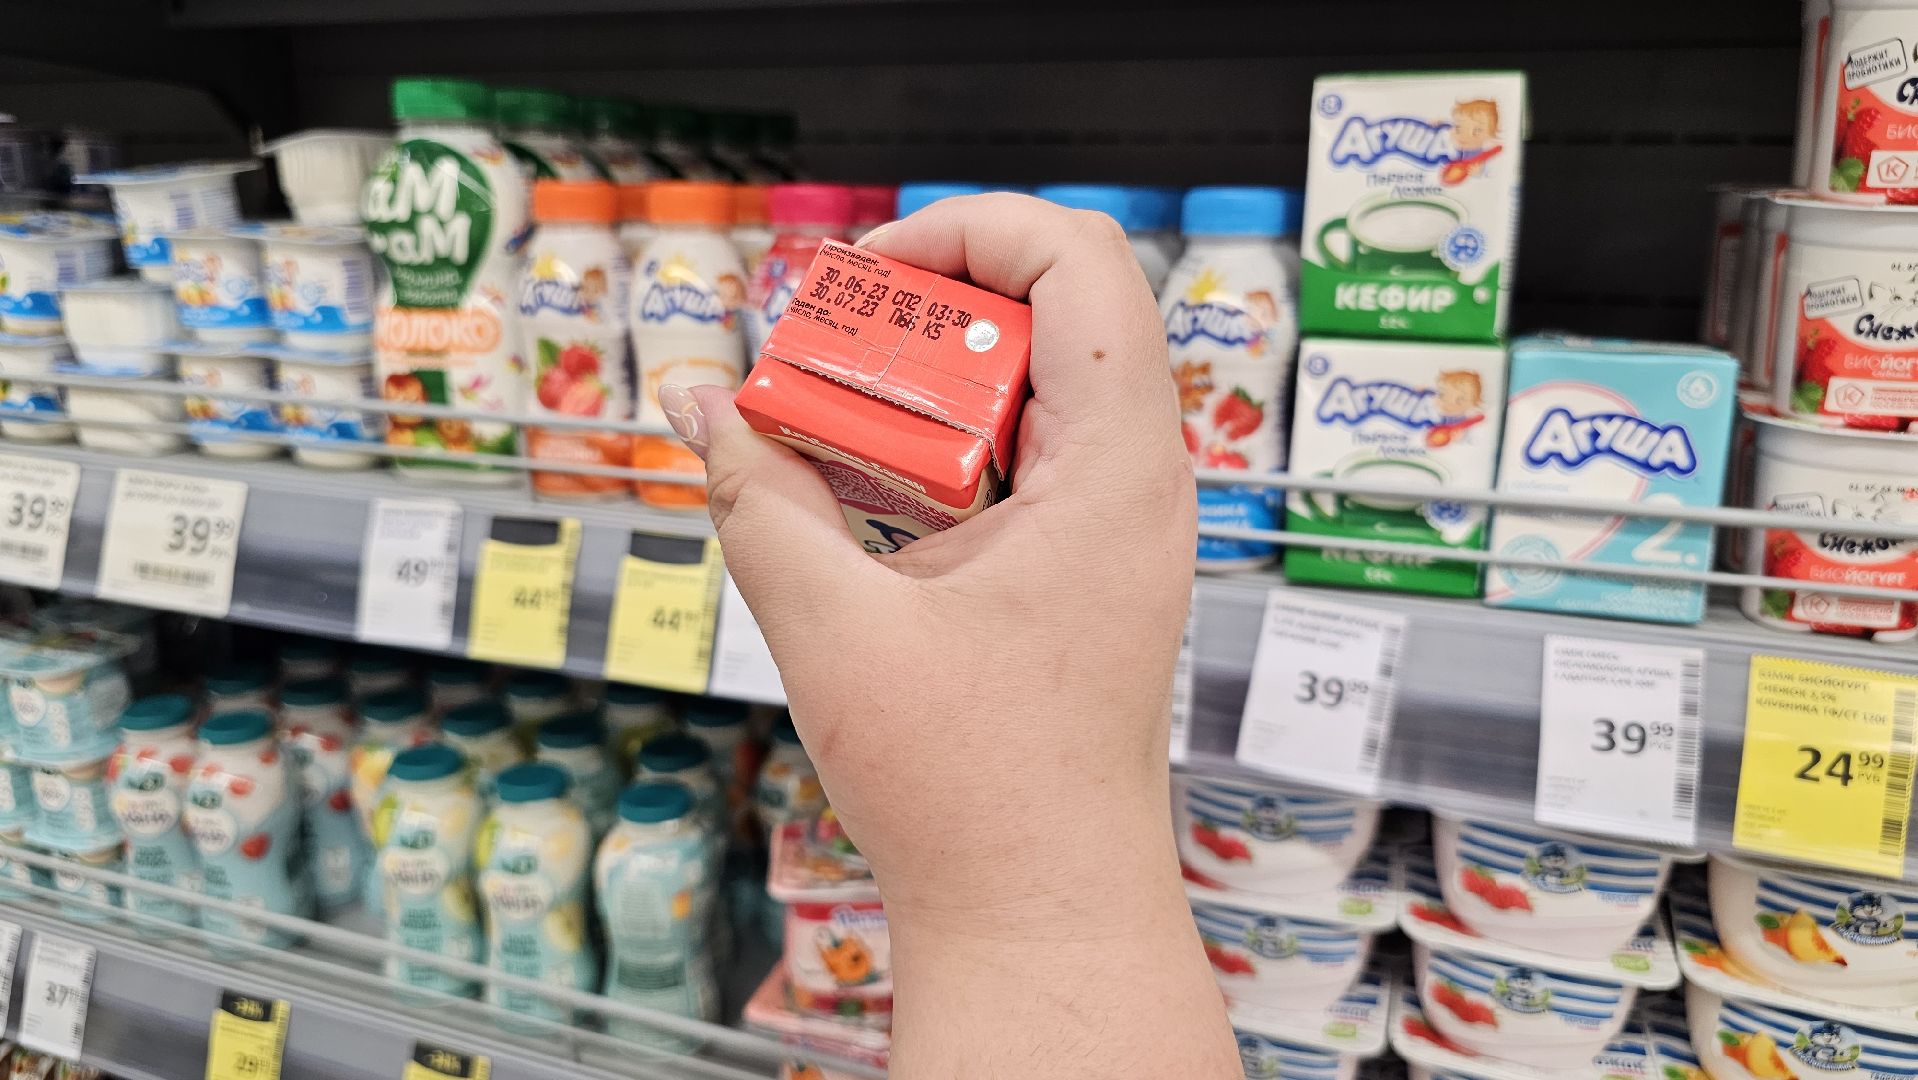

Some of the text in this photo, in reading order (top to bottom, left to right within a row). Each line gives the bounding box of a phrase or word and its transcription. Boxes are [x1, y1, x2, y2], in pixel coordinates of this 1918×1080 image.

[809, 280, 880, 318] 30.07.23
[820, 266, 890, 301] 30.06.23
[926, 301, 972, 329] 03:30
[1334, 282, 1457, 313] КЕФИР
[168, 513, 212, 552] 39
[1294, 669, 1345, 709] 39
[1590, 716, 1647, 756] 39
[1794, 744, 1886, 787] 24 99
